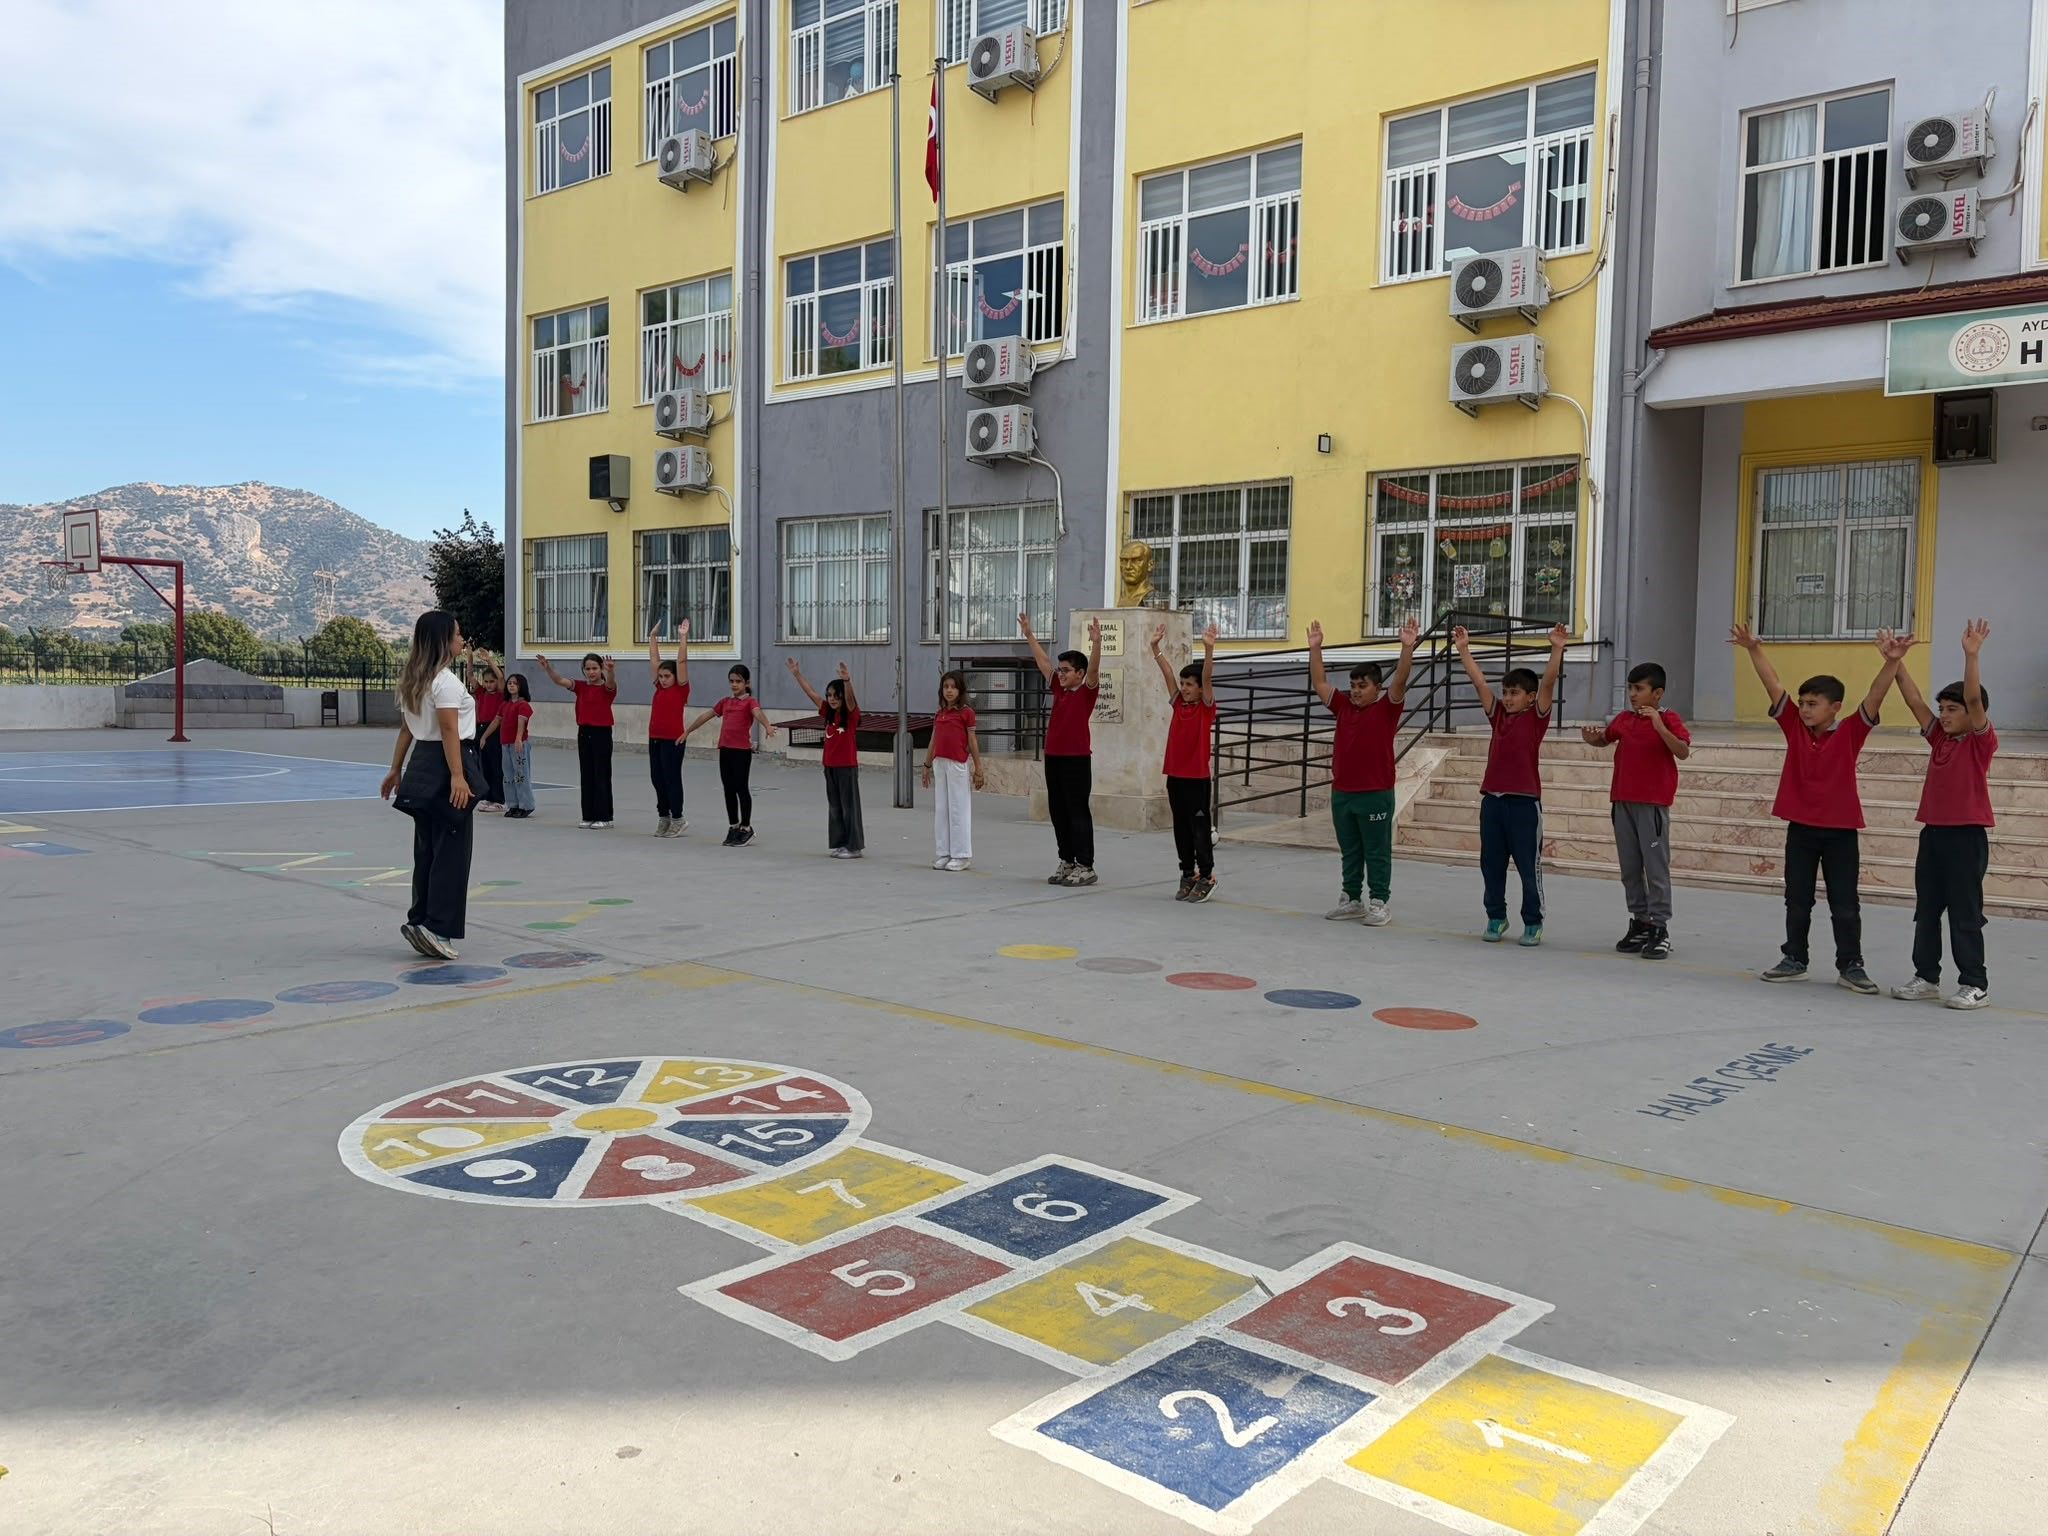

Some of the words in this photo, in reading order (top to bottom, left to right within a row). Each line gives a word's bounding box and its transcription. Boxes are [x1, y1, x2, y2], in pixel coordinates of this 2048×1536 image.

[1005, 32, 1013, 66] VESTEL
[1962, 116, 1973, 154] VESTEL
[1952, 194, 1966, 236] VESTEL
[1510, 256, 1521, 298] VESTEL
[1509, 344, 1520, 386] VESTEL
[1002, 413, 1010, 445] VESTEL
[1369, 812, 1387, 820] EA7
[533, 1067, 618, 1090] 12
[660, 1066, 754, 1090] 13
[423, 1088, 519, 1114] 11
[730, 1084, 826, 1111] 14
[1636, 1077, 1746, 1122] HALAT
[373, 1126, 485, 1156] 10
[716, 1122, 815, 1152] 15
[462, 1159, 537, 1185] 9
[621, 1154, 696, 1181] 8
[796, 1179, 867, 1208] 7
[1012, 1192, 1089, 1222] 6
[830, 1259, 917, 1297] 5
[1075, 1281, 1156, 1317] 4
[1325, 1296, 1429, 1336] 3
[1157, 1389, 1279, 1448] 2
[1472, 1417, 1592, 1464] 1
